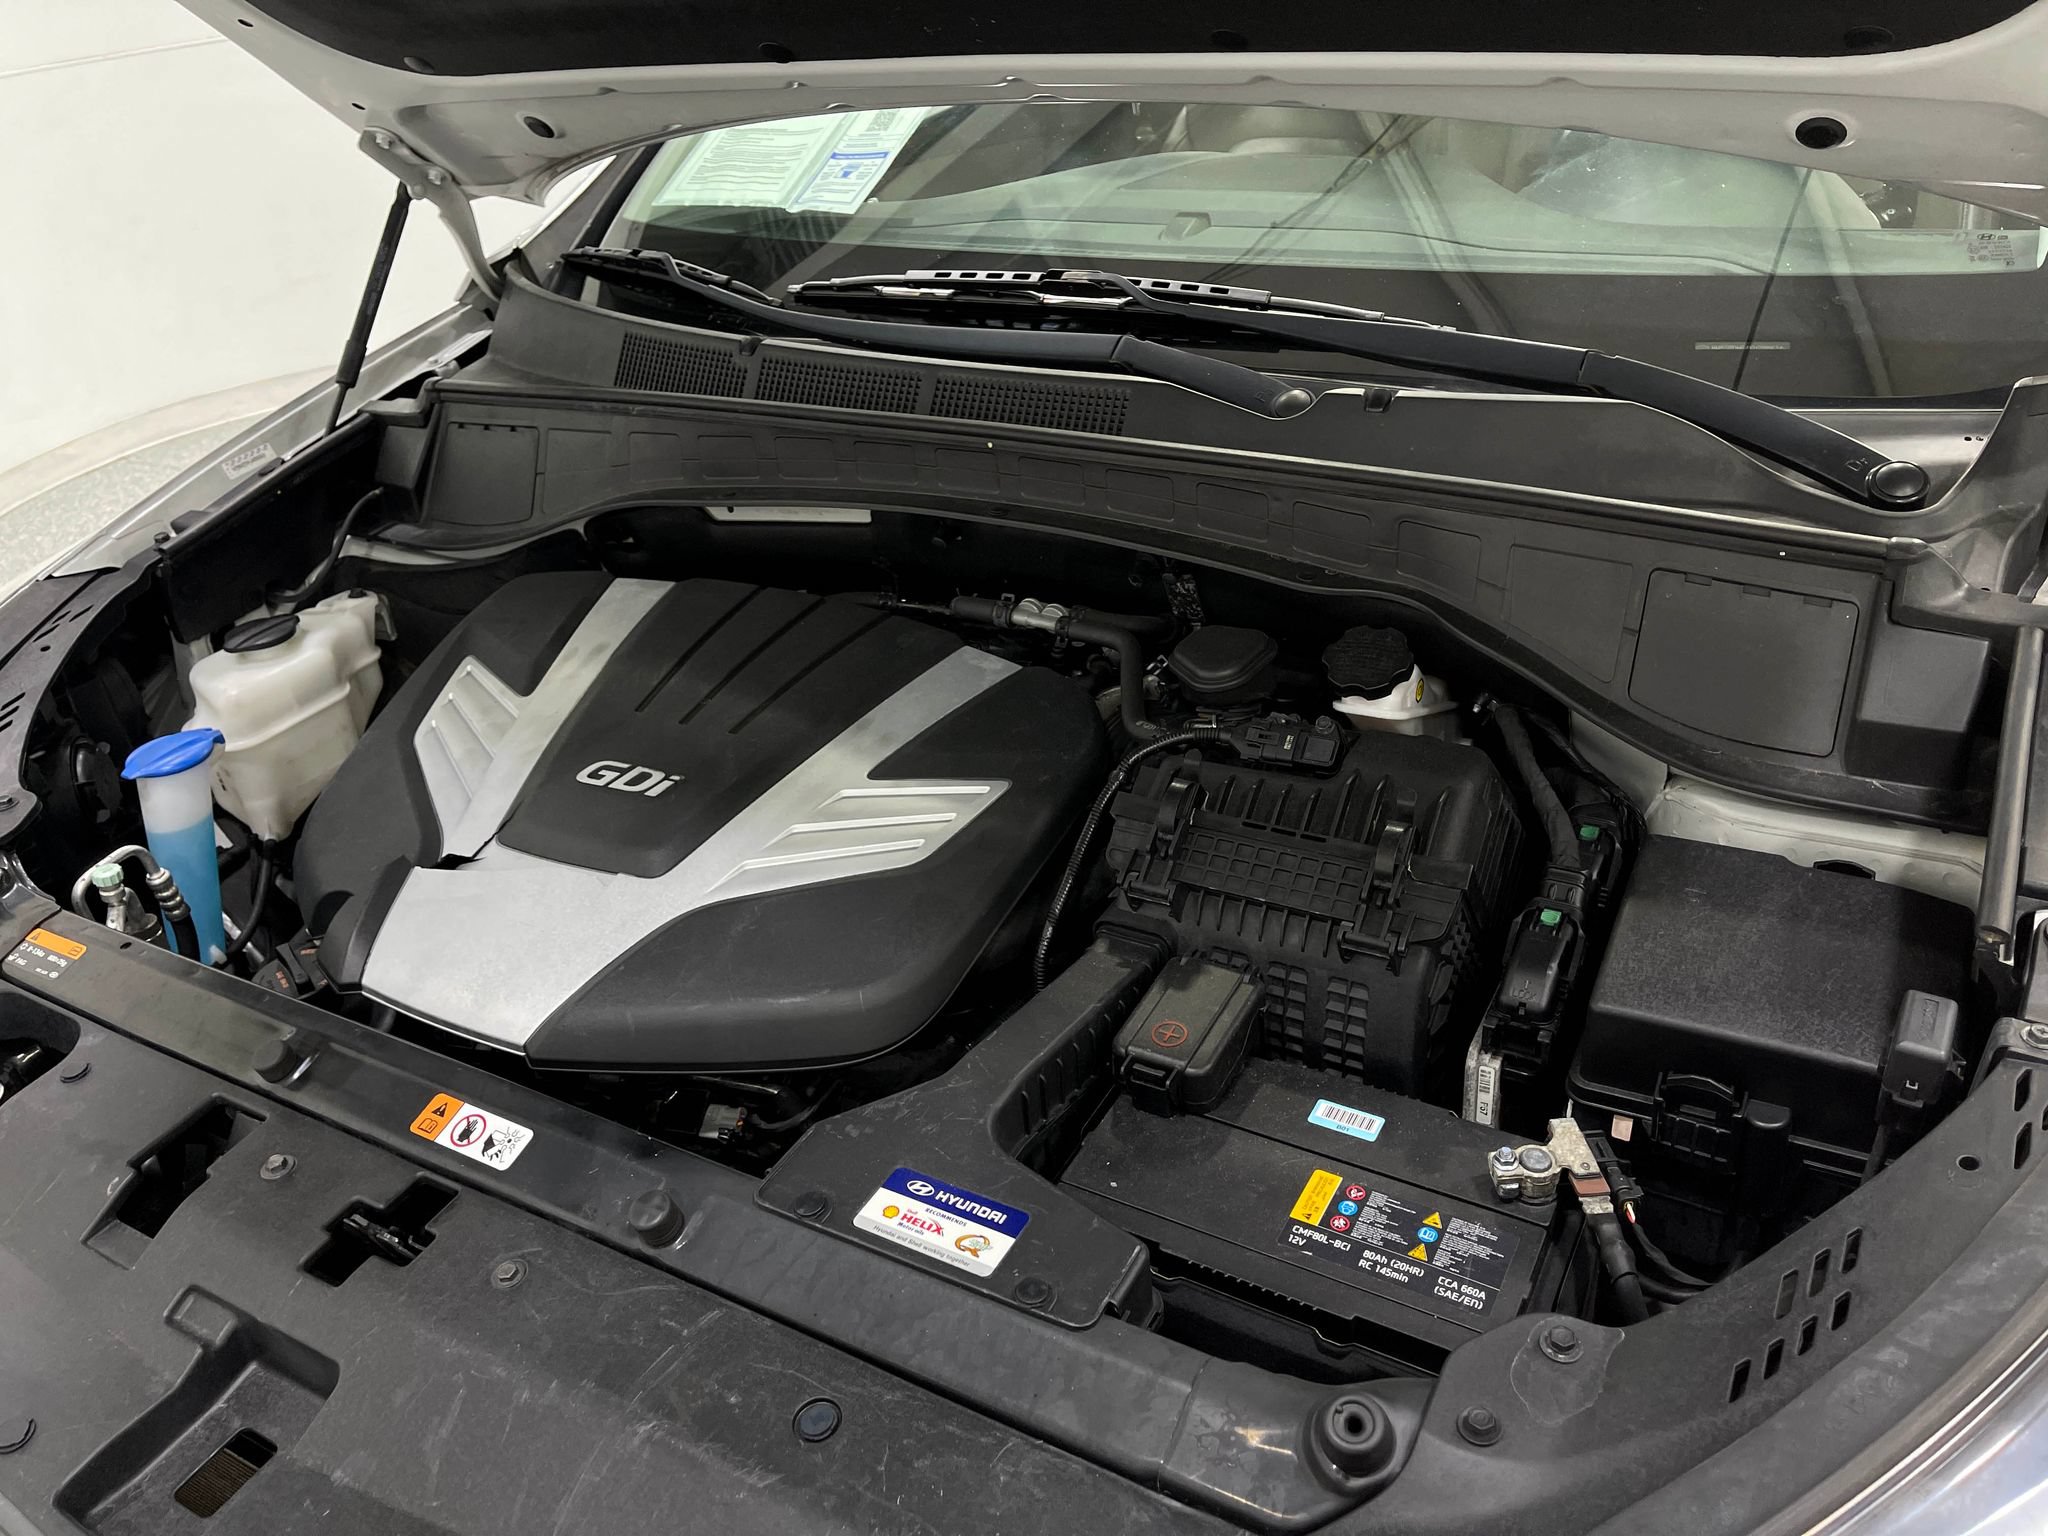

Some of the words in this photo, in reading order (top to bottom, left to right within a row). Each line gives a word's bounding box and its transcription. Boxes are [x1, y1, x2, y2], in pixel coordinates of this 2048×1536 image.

[576, 760, 683, 797] GDi
[924, 1207, 968, 1227] RECOMMENDS
[935, 1191, 1007, 1225] HYUNDAI
[897, 1222, 914, 1231] Motor
[900, 1213, 944, 1237] HELIX
[873, 1225, 896, 1239] Hyundai
[896, 1233, 908, 1242] and
[908, 1238, 923, 1249] Shell
[923, 1244, 945, 1258] working
[946, 1252, 971, 1267] together
[1288, 1234, 1307, 1247] 12V
[1291, 1225, 1351, 1252] CMF80L-BCI
[1358, 1259, 1372, 1271] RC
[1375, 1264, 1410, 1284] 145min
[1362, 1249, 1388, 1266] 80Ah
[1390, 1257, 1425, 1278] (20HR)
[1438, 1275, 1459, 1291] CCA
[1460, 1283, 1487, 1301] 660A
